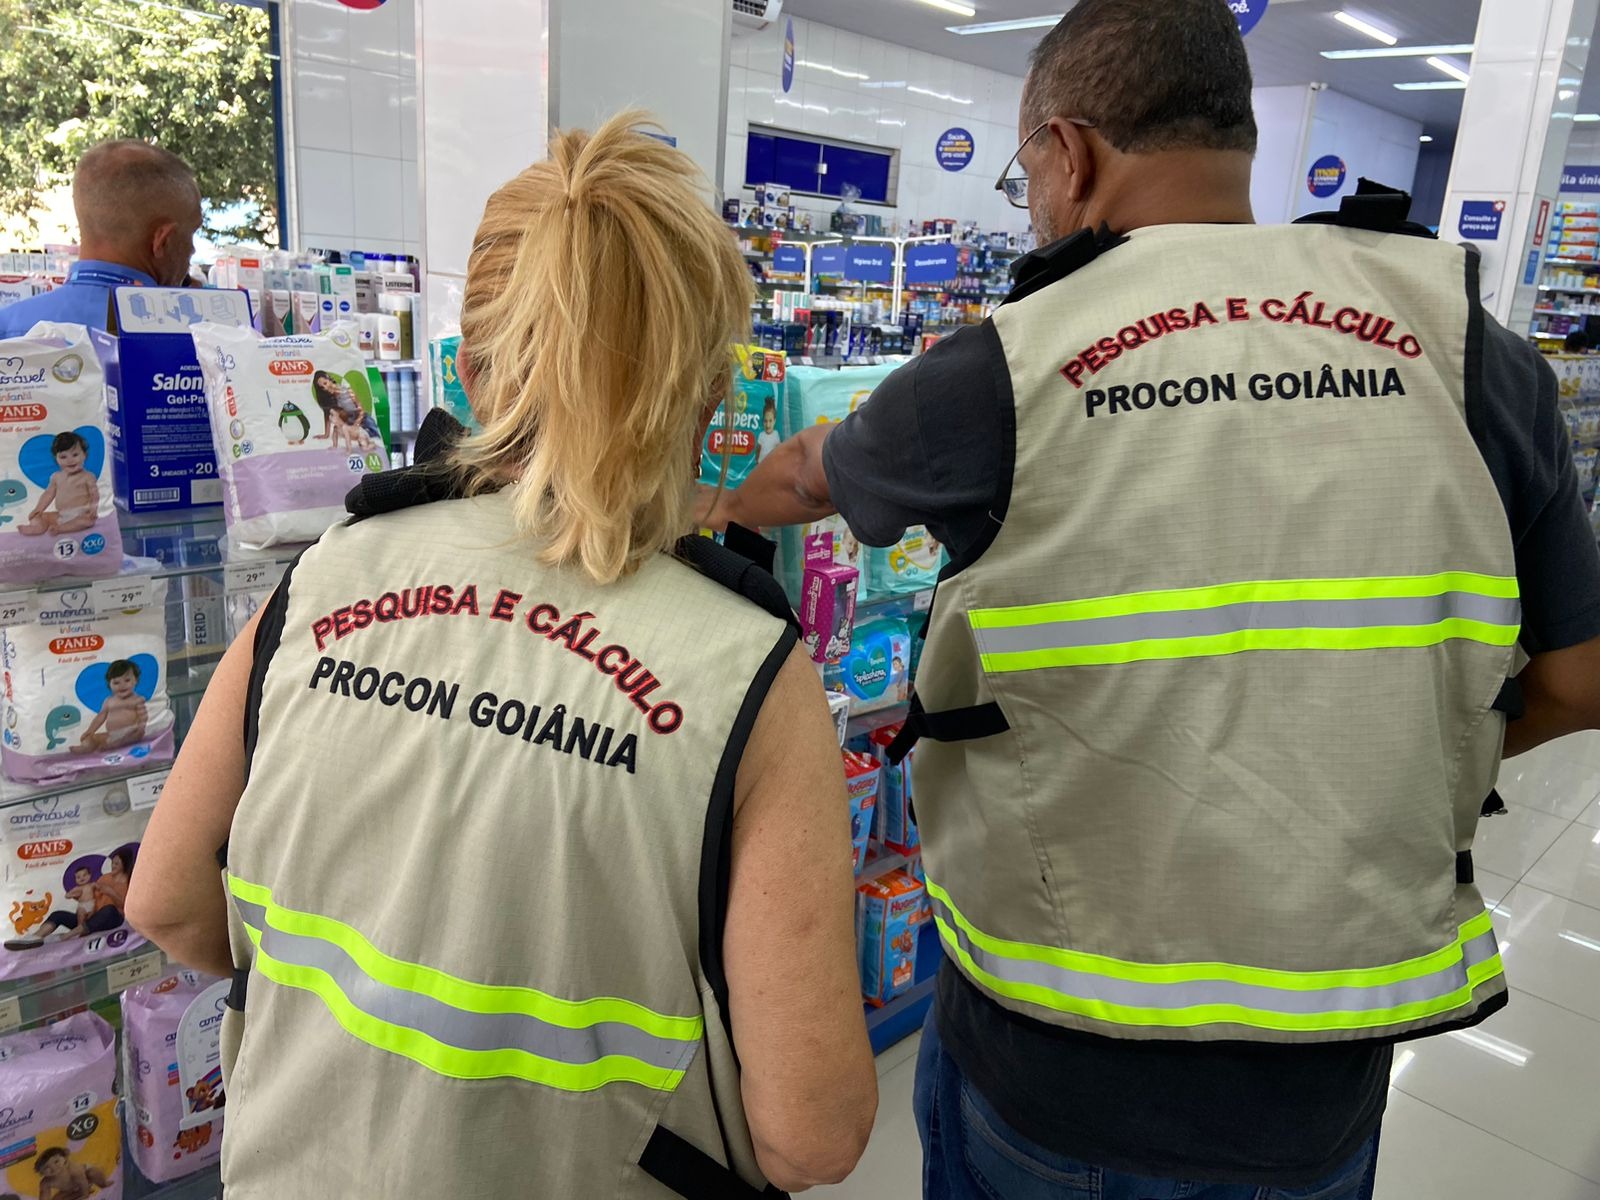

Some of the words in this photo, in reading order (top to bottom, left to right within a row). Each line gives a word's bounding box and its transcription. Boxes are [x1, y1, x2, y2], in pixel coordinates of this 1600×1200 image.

[1059, 301, 1219, 389] PESQUISA
[1226, 298, 1250, 321] E
[1259, 291, 1423, 359] CÁLCULO
[273, 361, 310, 372] PANTS
[1085, 373, 1237, 418] PROCON
[1248, 364, 1406, 401] GOIÂNIA
[713, 431, 750, 448] pnts
[149, 465, 160, 478] 3
[195, 462, 213, 475] 20
[348, 459, 364, 471] 20
[368, 455, 381, 467] M
[57, 543, 75, 556] 13
[246, 573, 259, 583] 29
[121, 592, 134, 603] 29
[2, 609, 17, 619] 29
[194, 606, 207, 645] FERID
[55, 637, 98, 650] PANTS
[310, 584, 479, 652] PESQUISA
[489, 588, 523, 622] E
[525, 602, 684, 735] CÁLCULO
[308, 656, 460, 720] PROCON
[468, 691, 638, 774] GOIÂNIA
[24, 840, 67, 856] PANTS
[73, 1097, 90, 1109] 14
[71, 1116, 95, 1136] XG
